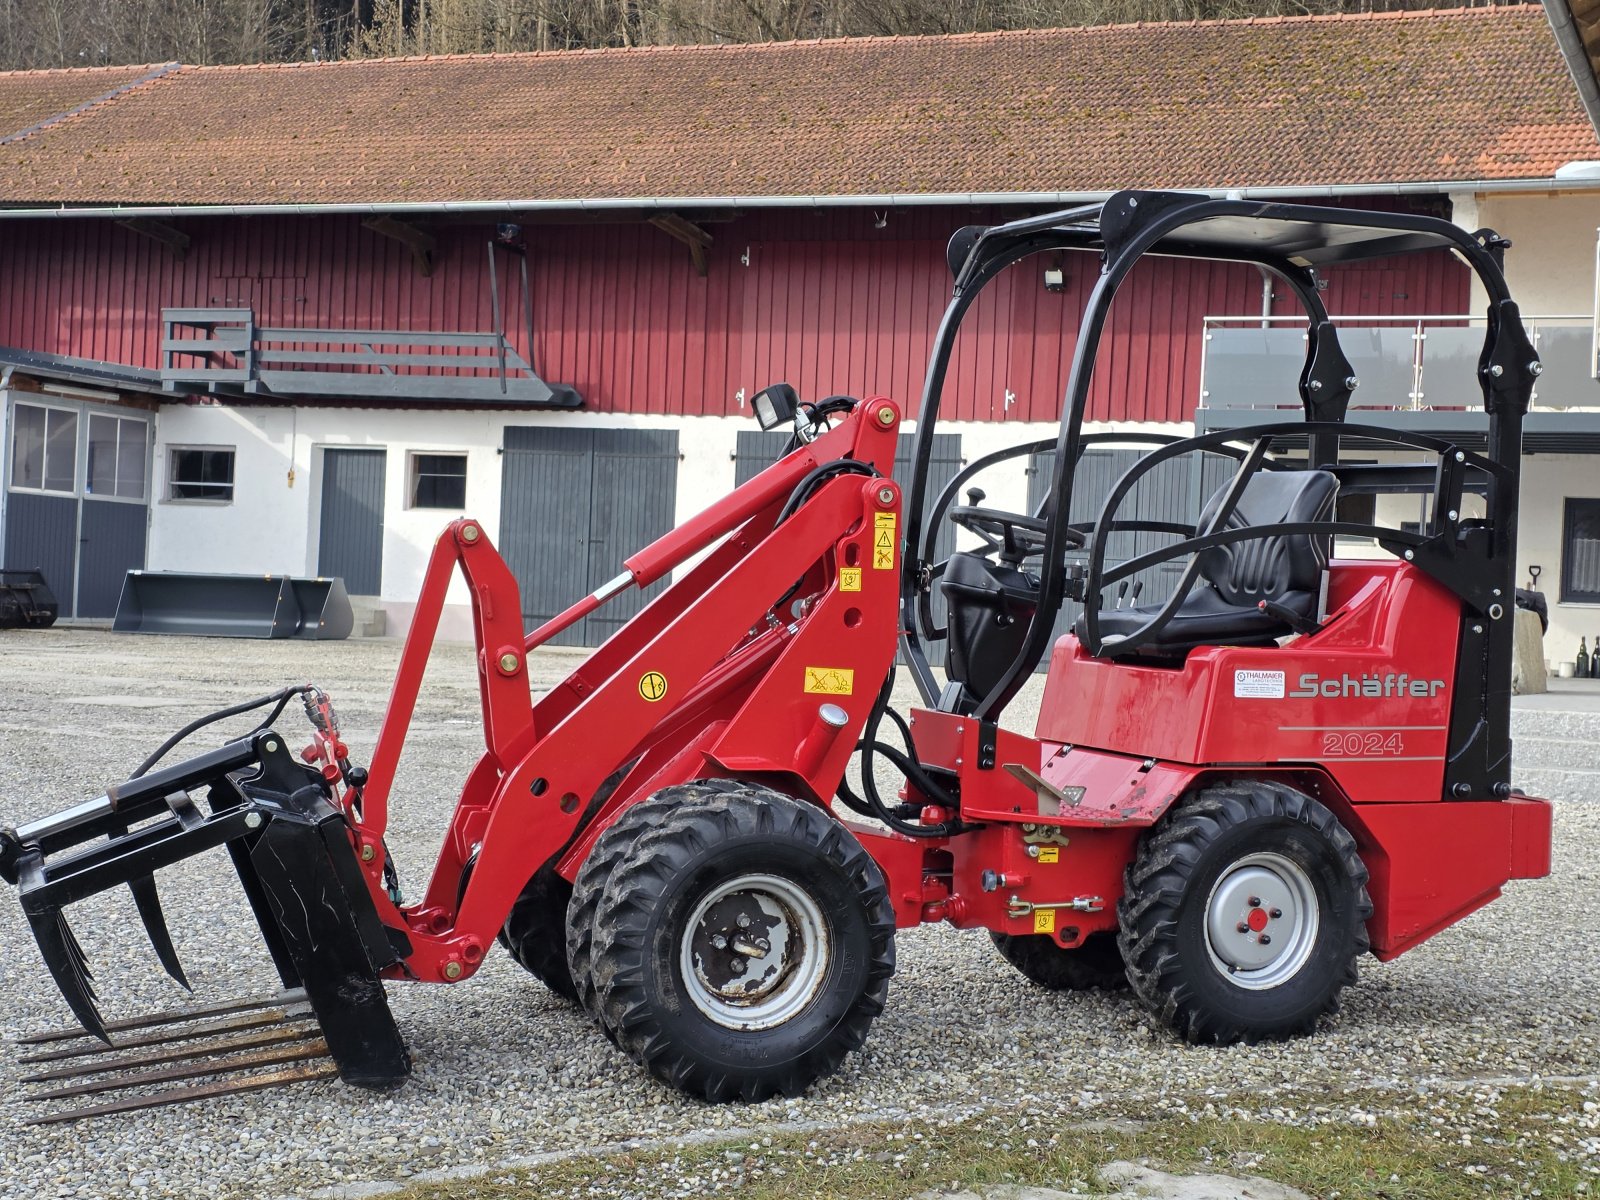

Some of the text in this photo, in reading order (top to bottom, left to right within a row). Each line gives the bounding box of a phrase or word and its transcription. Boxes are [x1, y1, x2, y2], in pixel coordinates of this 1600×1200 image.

[1245, 672, 1283, 680] THALMAIER
[1289, 673, 1446, 698] Schäffer
[1322, 732, 1404, 755] 2024
